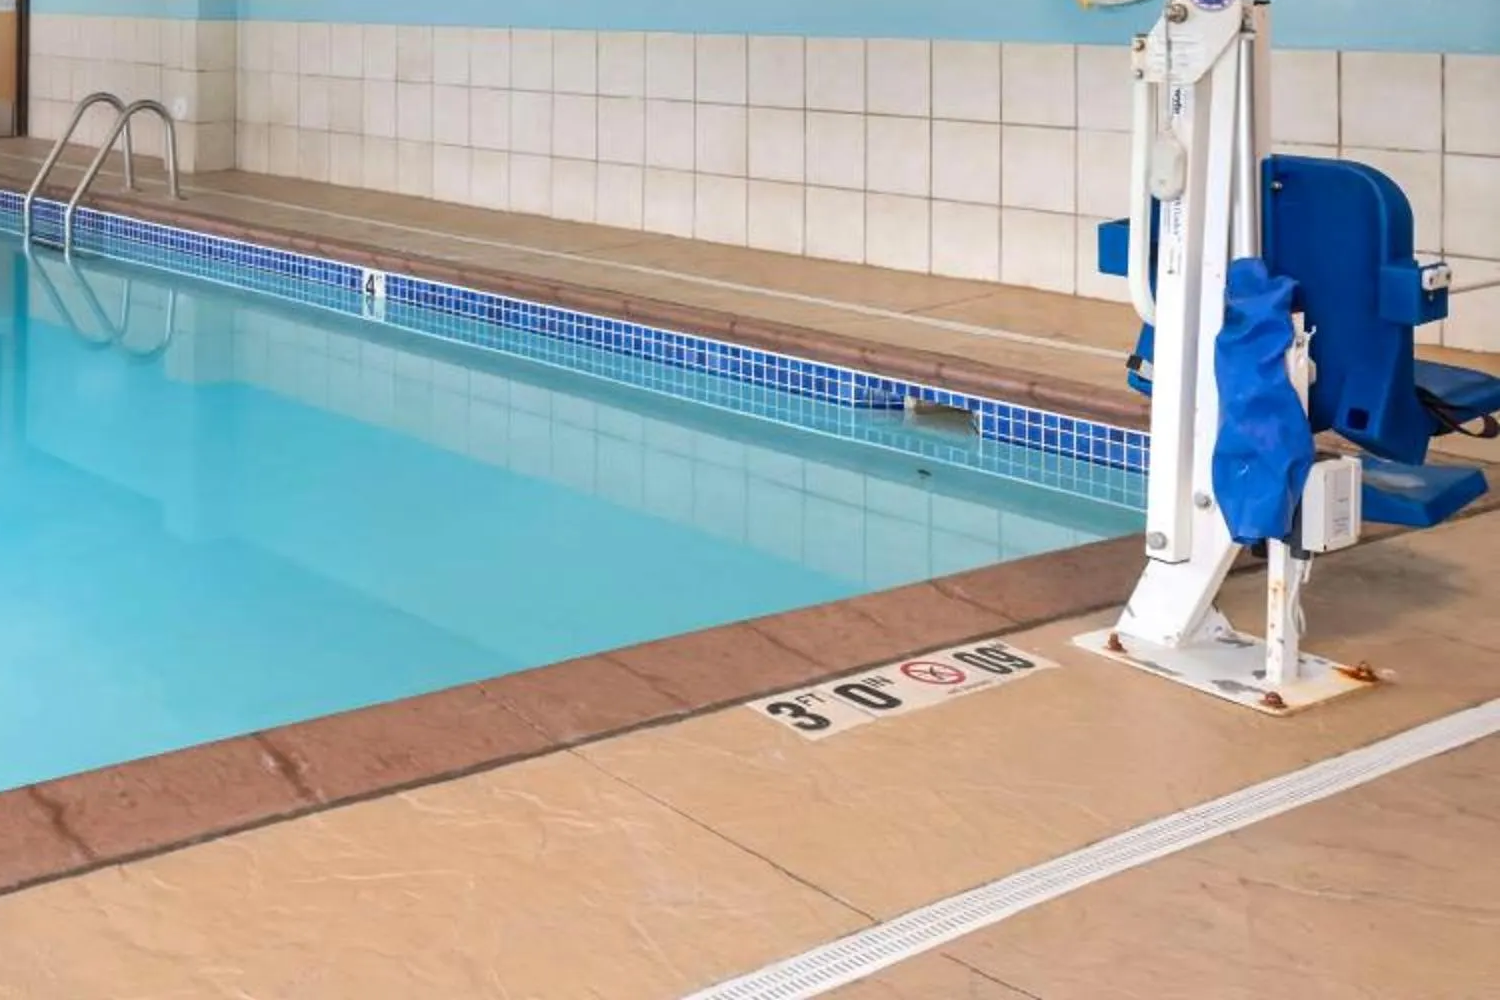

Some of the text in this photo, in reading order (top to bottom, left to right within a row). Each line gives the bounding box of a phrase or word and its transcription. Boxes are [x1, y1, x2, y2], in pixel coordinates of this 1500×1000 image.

[365, 273, 376, 296] 4
[766, 701, 832, 731] 3
[833, 683, 903, 710] 0
